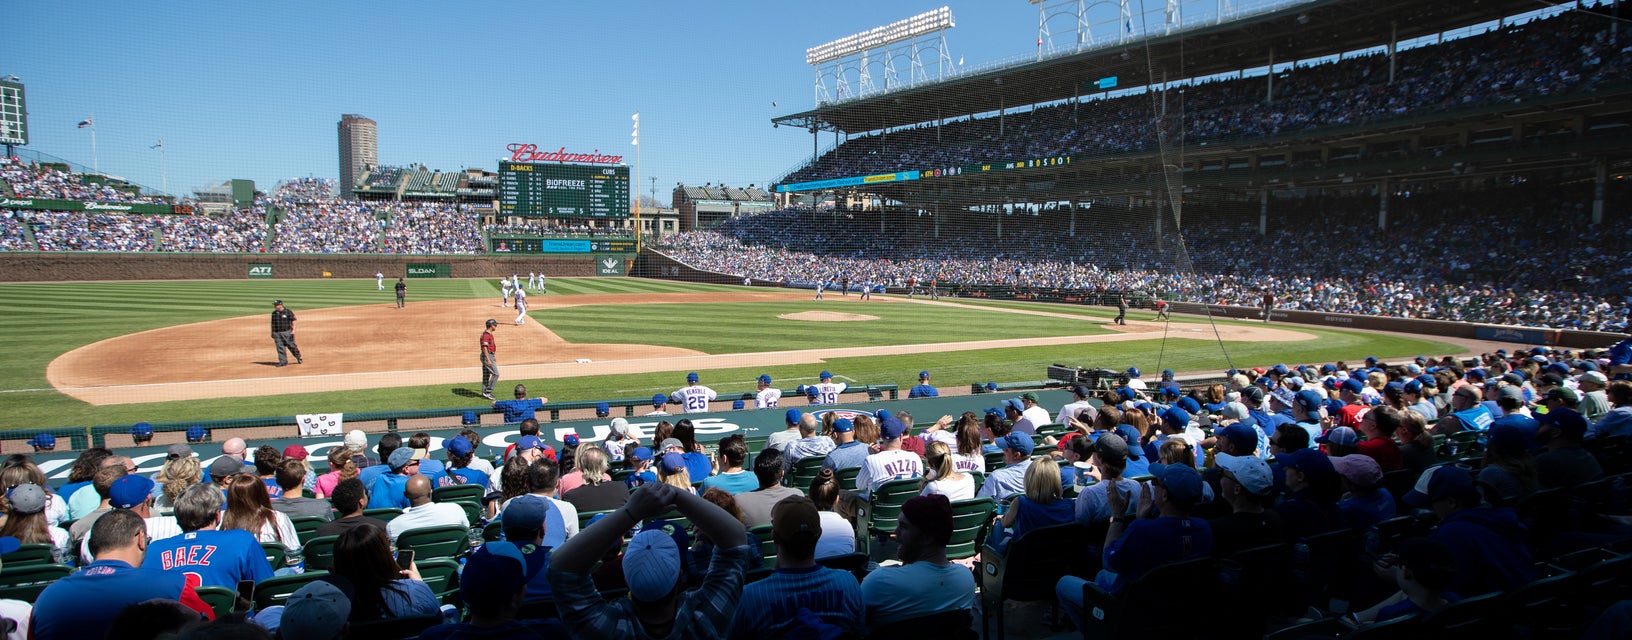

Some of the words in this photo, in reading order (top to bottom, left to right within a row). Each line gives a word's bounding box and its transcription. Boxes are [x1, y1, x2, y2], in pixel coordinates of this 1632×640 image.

[506, 143, 623, 164] Budweiser
[546, 179, 585, 187] BIOFREEZE
[83, 202, 132, 210] Budweiser
[688, 396, 706, 410] 25
[822, 392, 836, 404] 19
[884, 459, 917, 476] RIZZO
[957, 461, 979, 471] BRYANT
[161, 545, 218, 570] BAEZ
